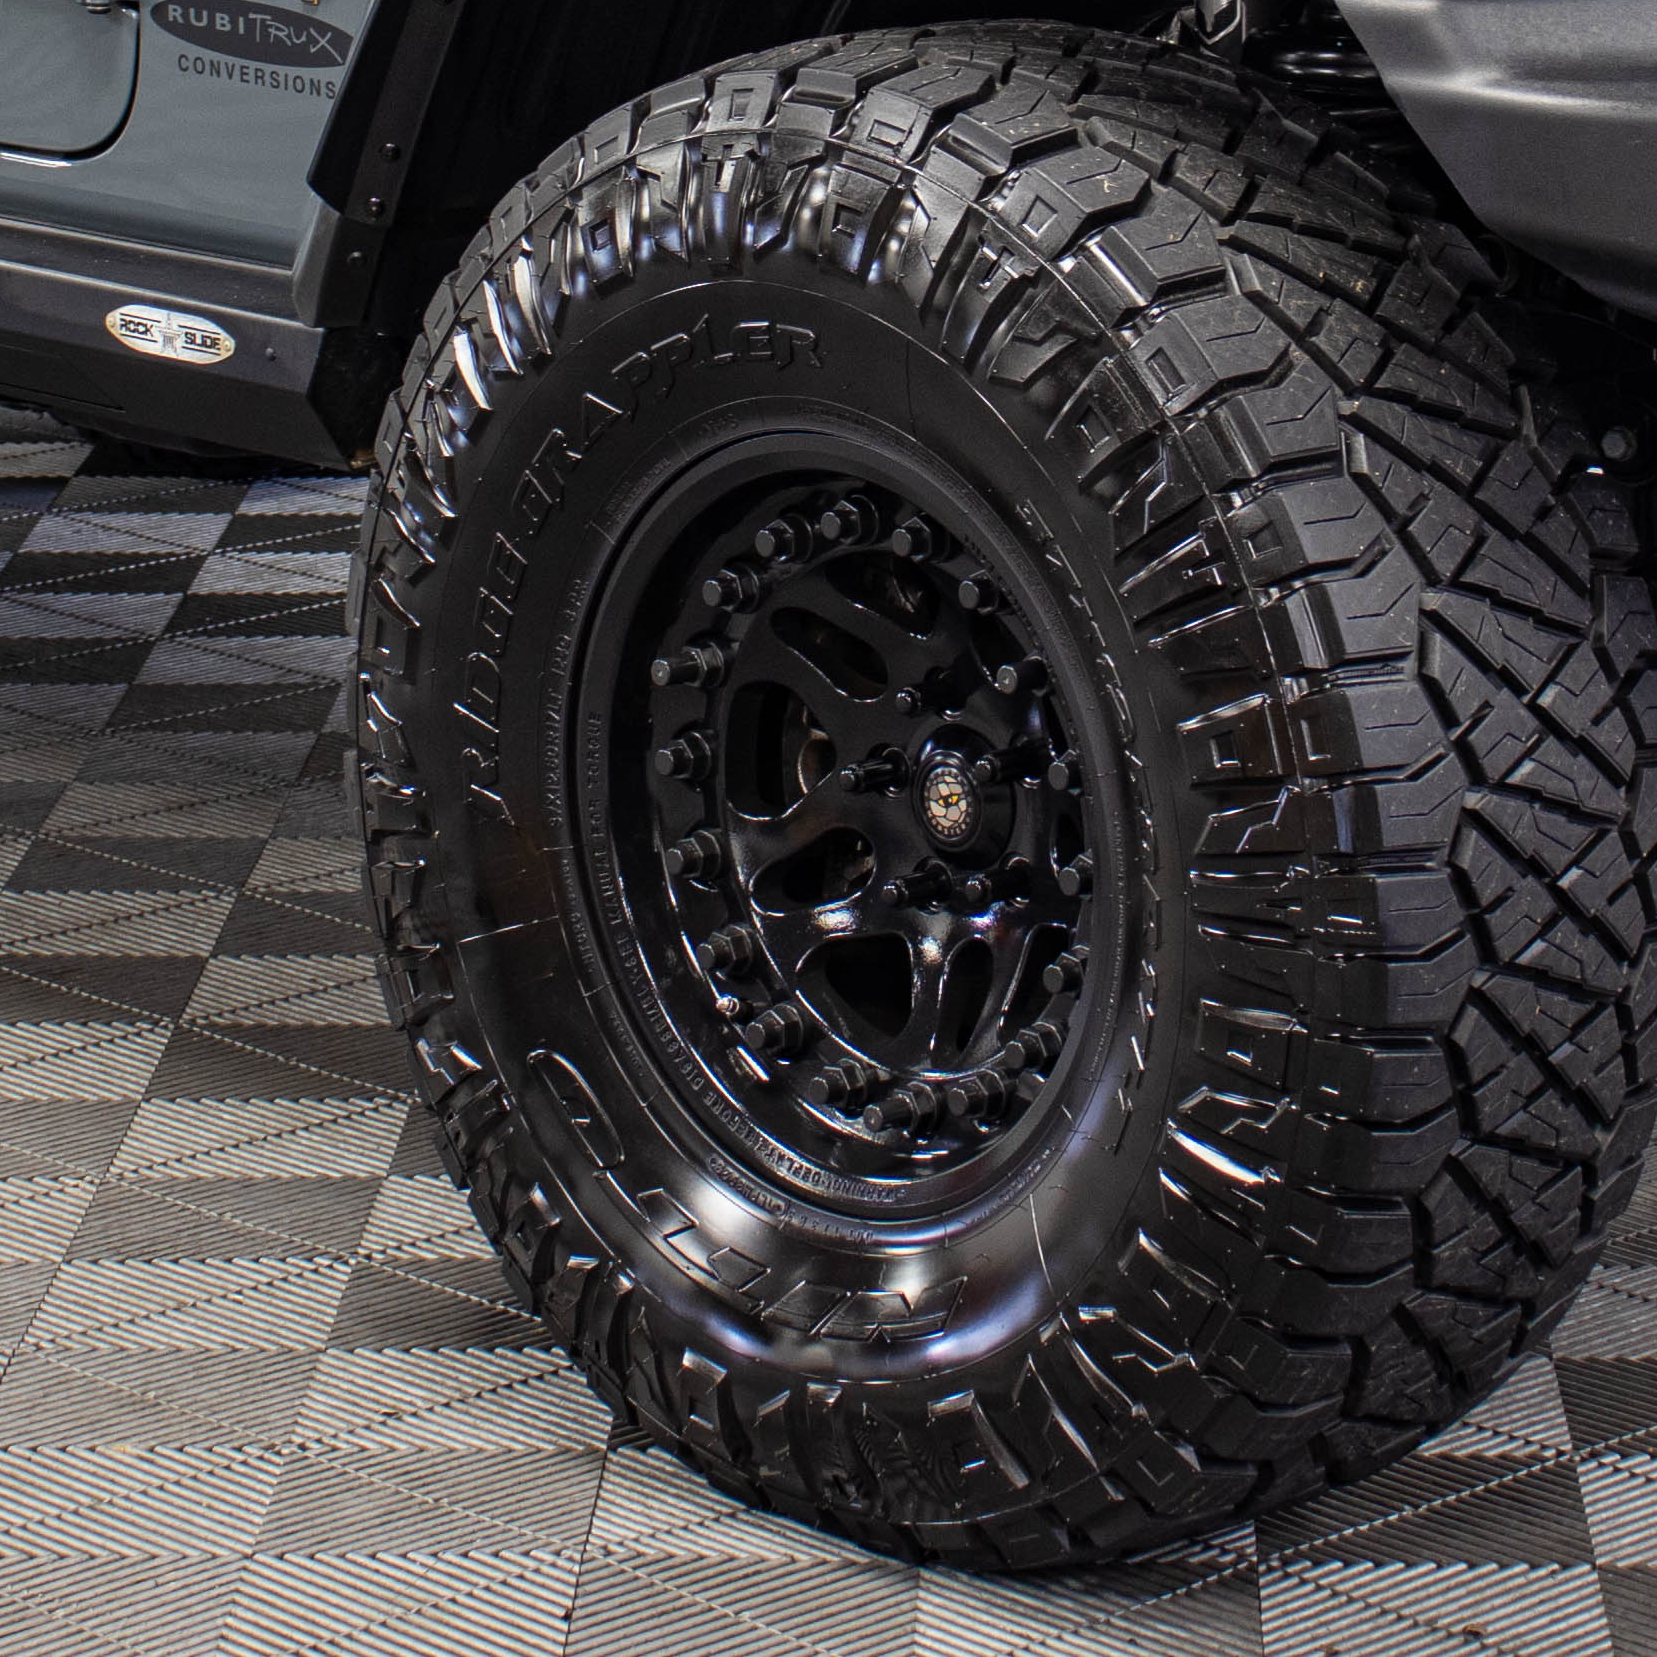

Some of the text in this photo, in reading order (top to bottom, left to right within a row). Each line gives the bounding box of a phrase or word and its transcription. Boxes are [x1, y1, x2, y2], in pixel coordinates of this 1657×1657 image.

[177, 53, 337, 100] CONVERSIONS
[119, 317, 222, 352] ROCK SLIDE
[510, 313, 825, 524] GRAPPLER
